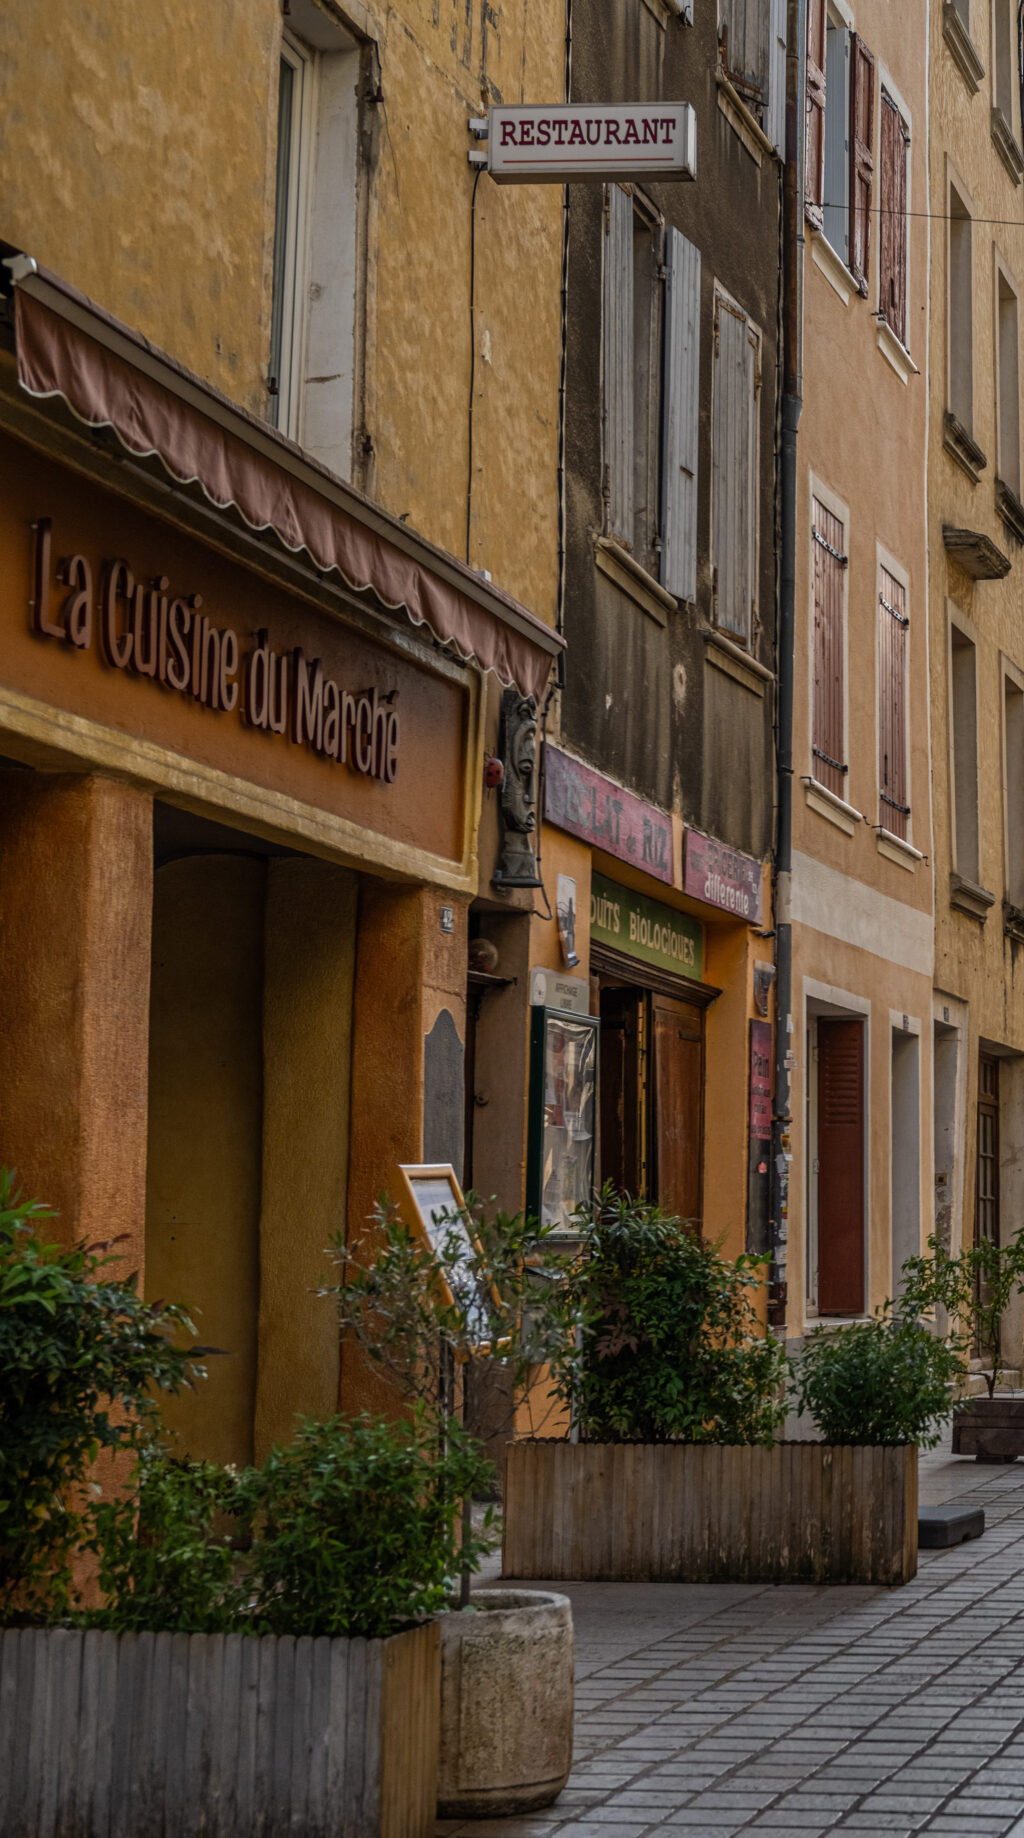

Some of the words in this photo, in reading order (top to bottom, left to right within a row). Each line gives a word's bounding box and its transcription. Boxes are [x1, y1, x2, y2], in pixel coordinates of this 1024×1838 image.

[500, 118, 676, 146] RESTAURANT
[35, 517, 93, 649] La
[103, 558, 238, 711] Cuisine
[247, 628, 287, 734] du
[292, 646, 399, 784] Marché
